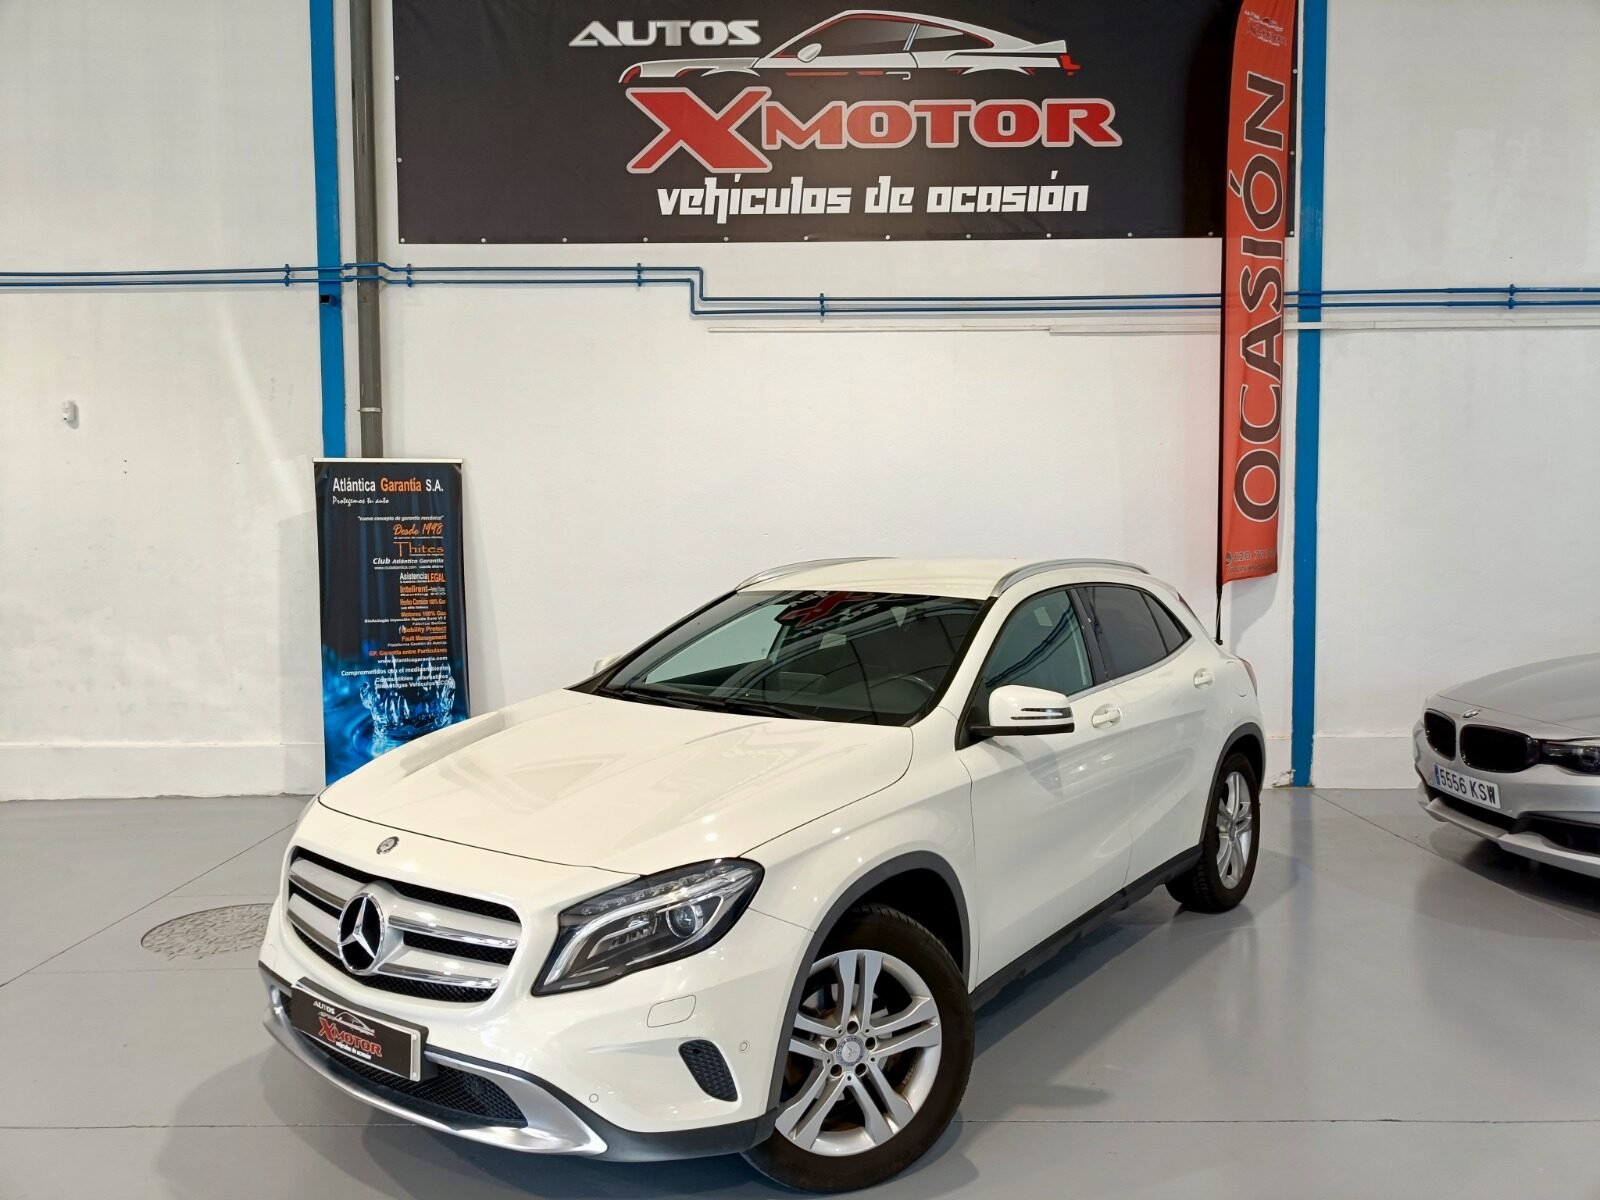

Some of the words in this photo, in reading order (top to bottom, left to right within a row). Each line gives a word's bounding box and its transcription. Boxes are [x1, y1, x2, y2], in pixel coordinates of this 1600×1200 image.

[568, 19, 761, 47] AUTOS
[626, 86, 1123, 174] XMOTOR
[657, 173, 852, 224] vehículos
[865, 176, 914, 213] de
[927, 170, 1089, 213] ocasión
[1228, 71, 1286, 522] OCASIÓN
[332, 477, 376, 492] Atlántica
[380, 477, 422, 492] Garantía
[425, 479, 444, 492] S.A.
[393, 523, 419, 535] Desde
[372, 557, 391, 565] Club
[341, 668, 386, 676] Comprometidos
[1440, 769, 1467, 794] 5556
[1470, 779, 1496, 804] KSW
[313, 1001, 335, 1014] AUTOS
